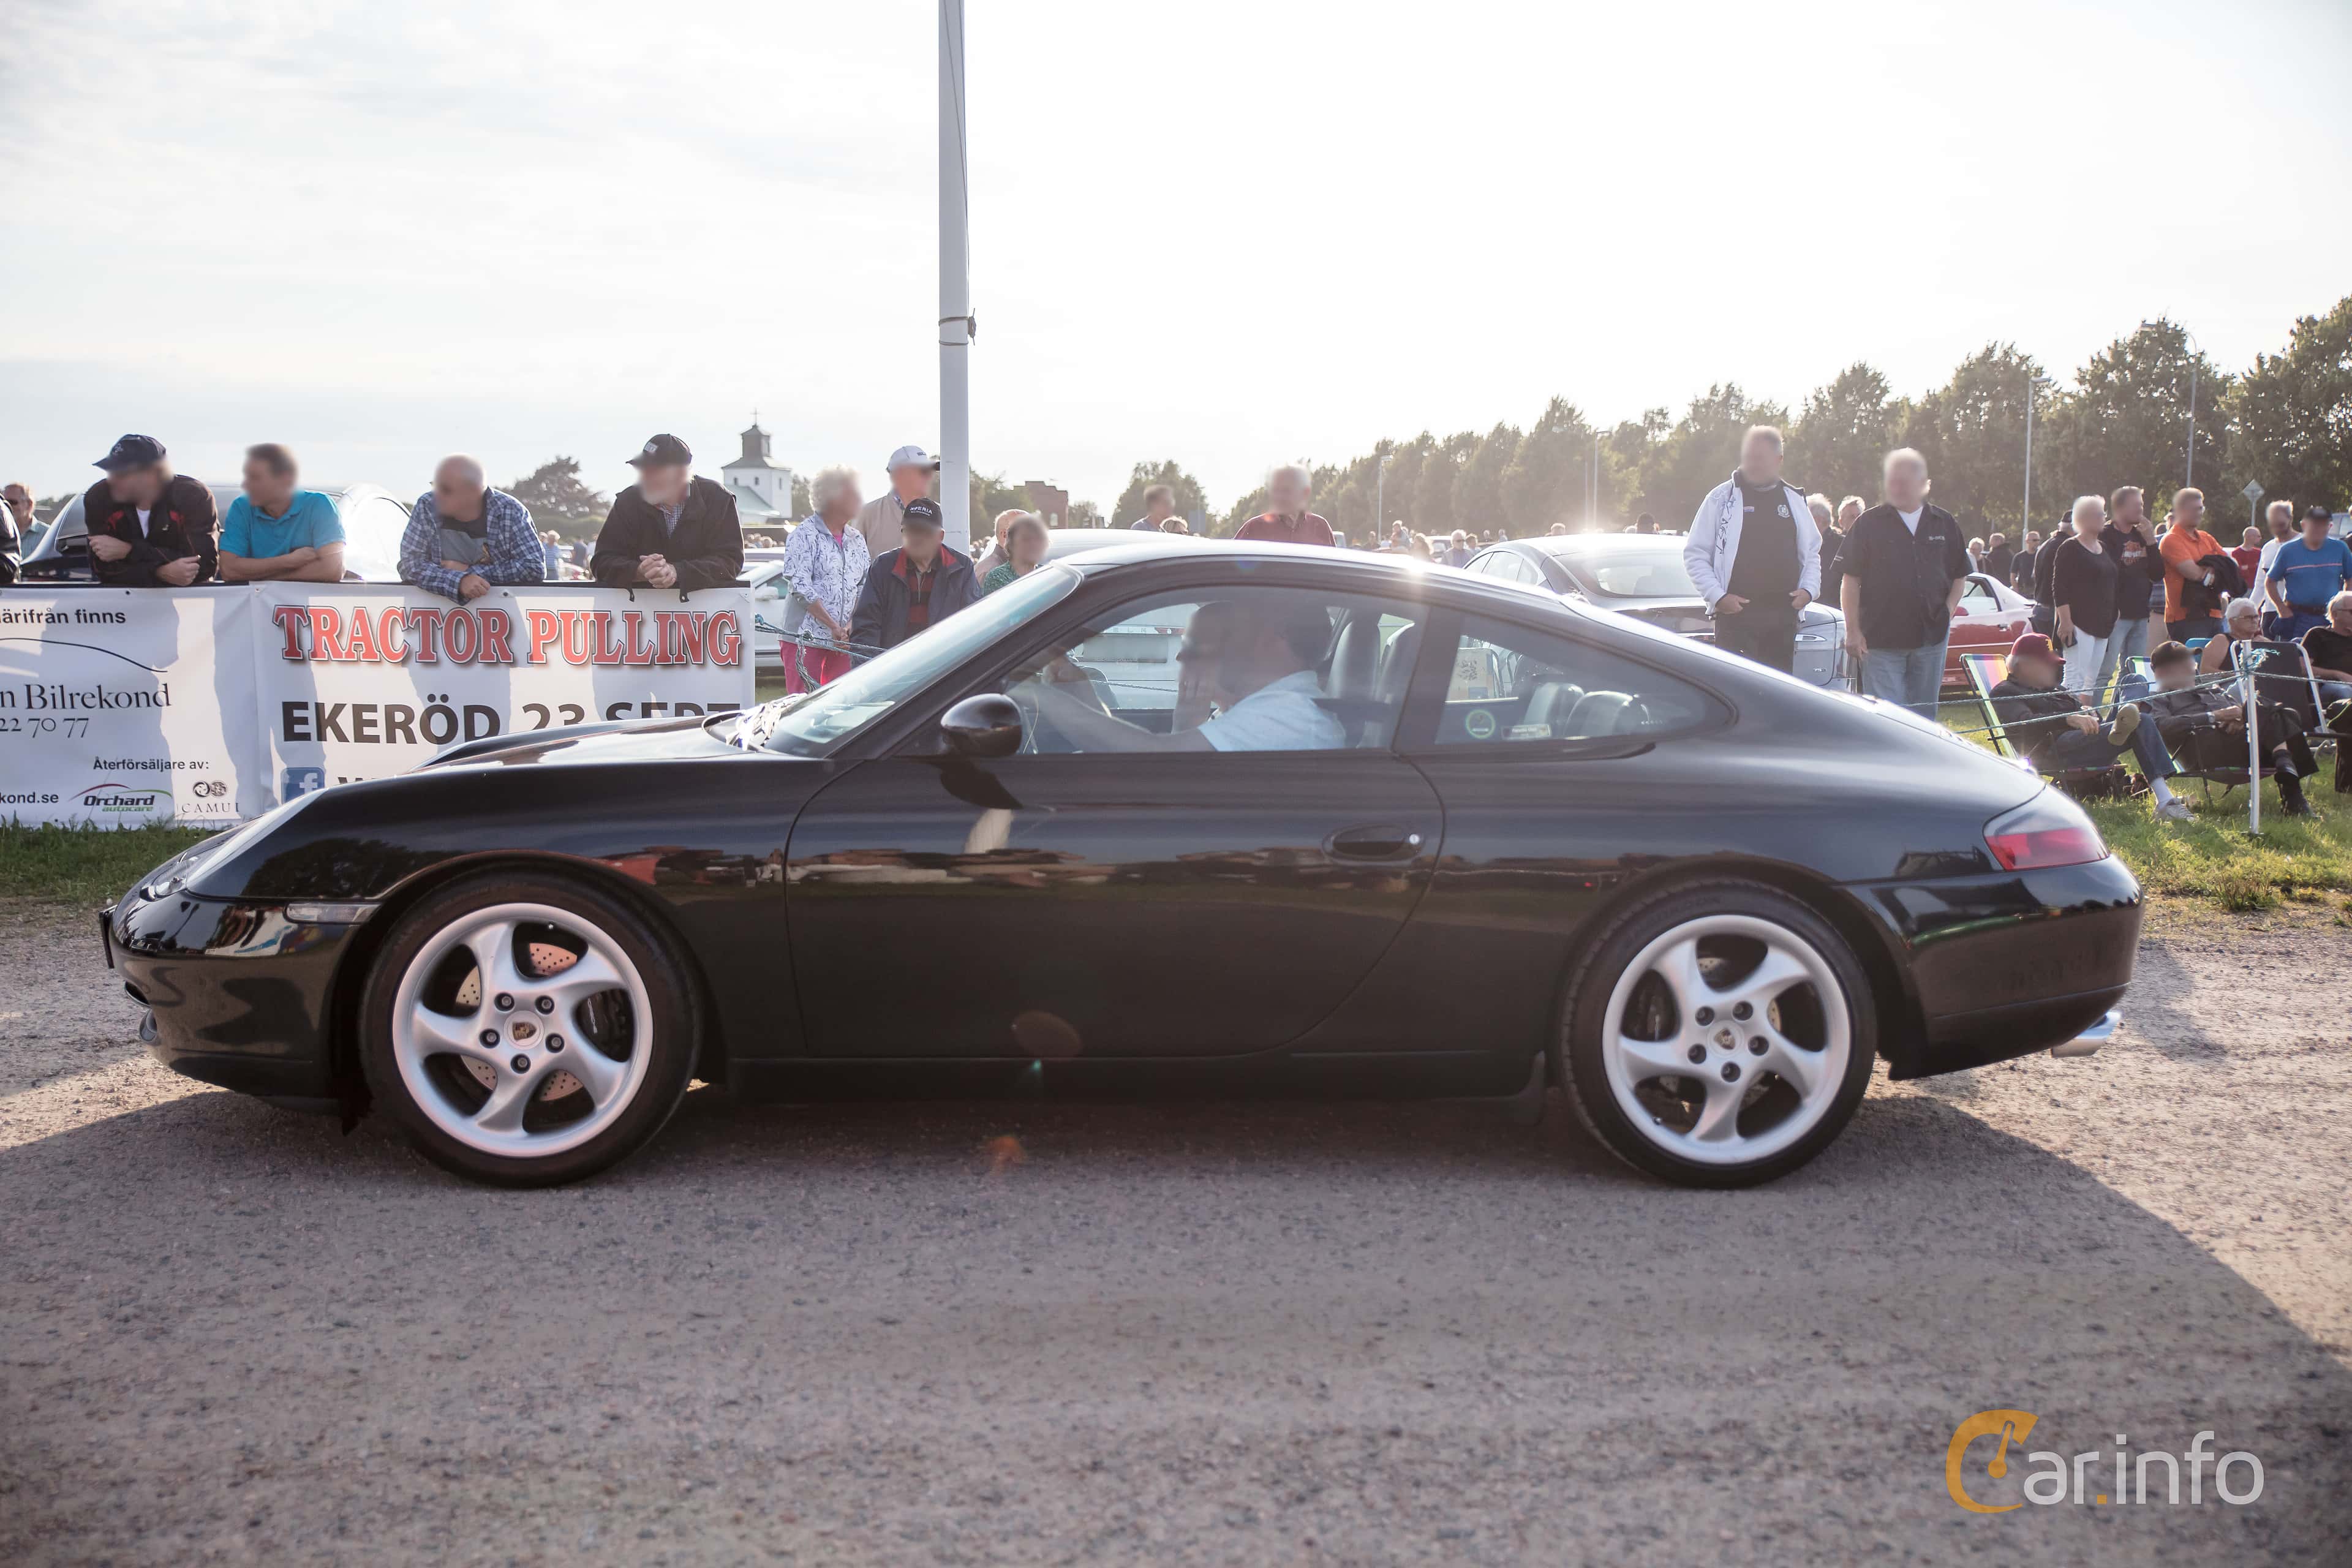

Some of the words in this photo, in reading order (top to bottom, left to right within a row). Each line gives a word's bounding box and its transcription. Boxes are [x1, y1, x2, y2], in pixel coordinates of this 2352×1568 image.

[0, 608, 69, 624] ärifrån
[75, 609, 126, 624] finns
[272, 605, 514, 664] TRACTOR
[527, 608, 742, 666] PULLING
[24, 683, 172, 709] Bilrekond
[28, 718, 56, 738] 70
[62, 718, 89, 738] 77
[282, 694, 500, 745] EKERÖD
[93, 756, 185, 772] Återförsäljare
[83, 795, 155, 806] Orchard
